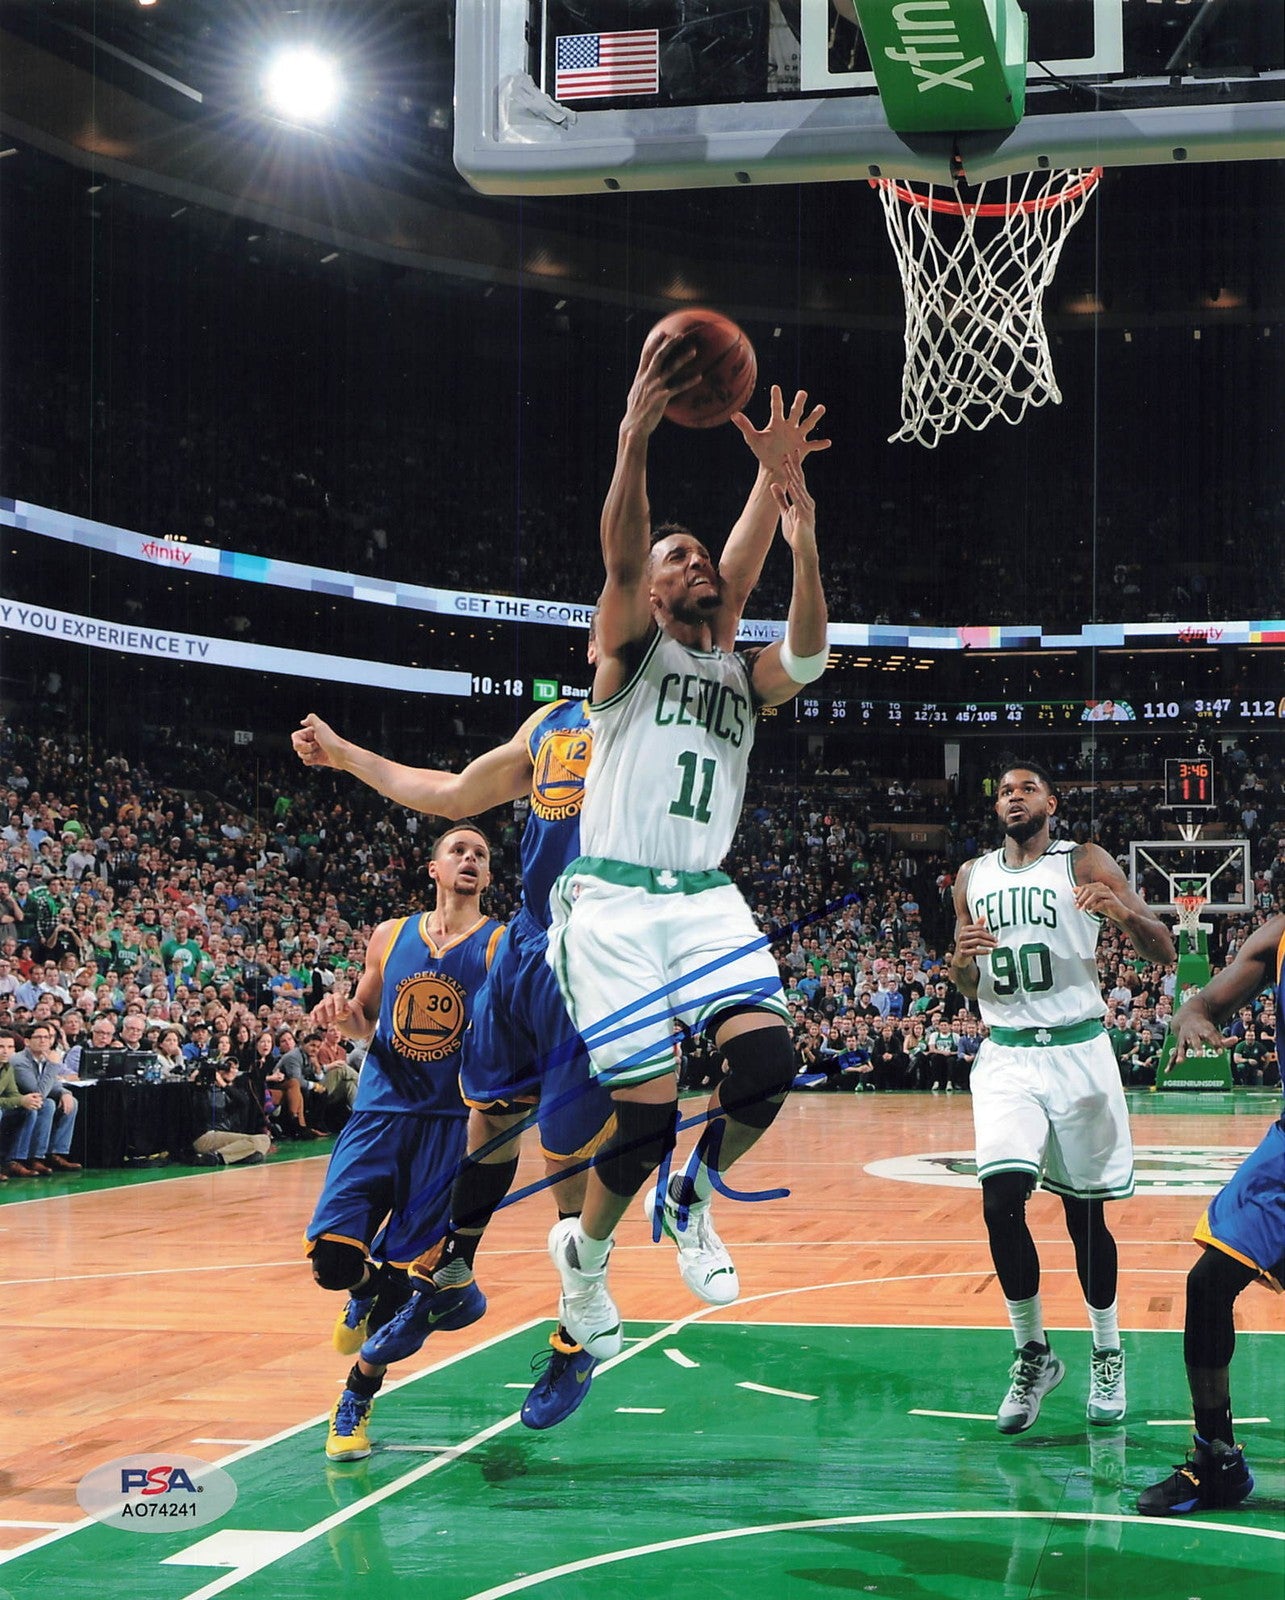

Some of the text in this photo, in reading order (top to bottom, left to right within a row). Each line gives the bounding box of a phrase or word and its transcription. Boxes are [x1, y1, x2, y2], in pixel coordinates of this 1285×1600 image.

[142, 541, 192, 565] xfinity
[455, 596, 779, 638] GET THE SCORE AME
[18, 608, 57, 631] YOU
[62, 619, 180, 653] EXPERIENCE
[185, 640, 210, 657] TV
[472, 676, 523, 696] 10:18
[562, 685, 591, 698] Ban
[804, 708, 819, 717] 49
[832, 708, 846, 718] 30
[862, 710, 869, 719] 6
[888, 710, 902, 720] 13
[914, 711, 948, 721] 12/31
[955, 711, 998, 721] 45/105
[1006, 711, 1022, 721] 43
[1143, 699, 1276, 718] 110 3:47 112
[566, 741, 587, 760] 12
[1180, 764, 1208, 777] 3:46
[668, 750, 717, 825] 11
[1182, 779, 1206, 800] 11
[991, 942, 1054, 996] 90
[395, 971, 467, 997] GOLDEN STATE
[427, 994, 453, 1014] 30
[391, 1033, 461, 1062] WARRIORS
